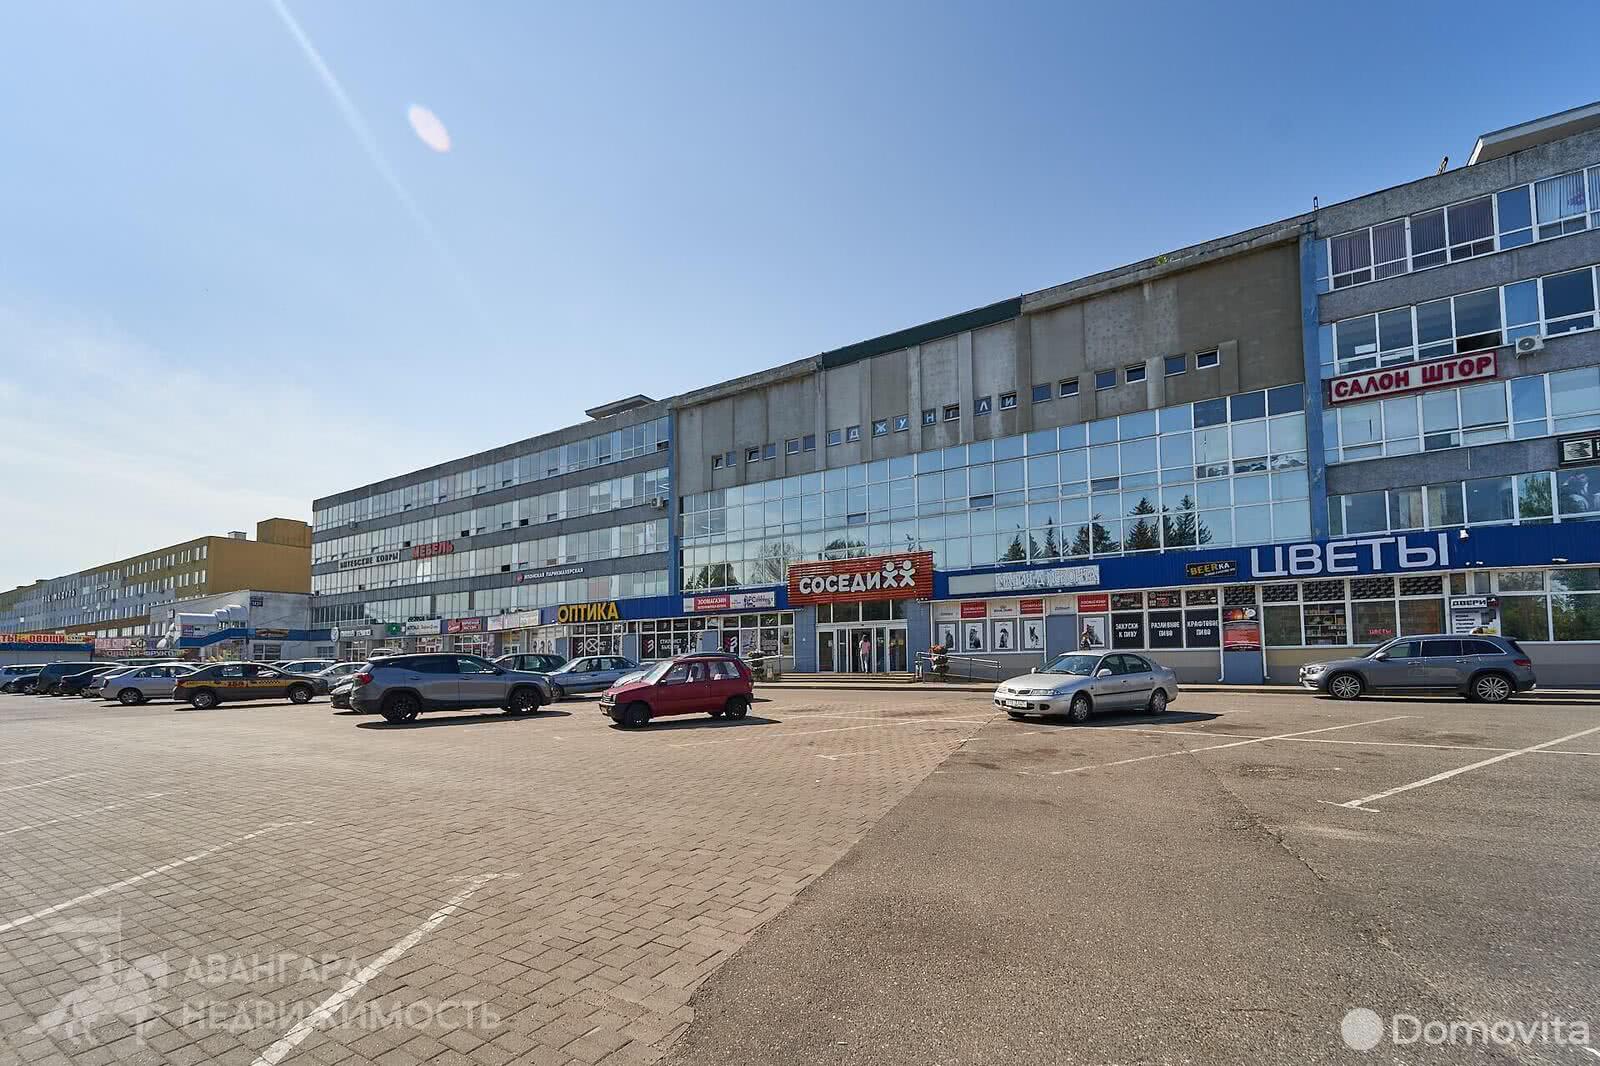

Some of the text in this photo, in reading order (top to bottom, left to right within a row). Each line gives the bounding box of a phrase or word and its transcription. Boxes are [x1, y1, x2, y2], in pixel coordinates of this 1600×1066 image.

[1335, 356, 1492, 398] САЛОН ШТОР
[1250, 533, 1450, 578] ЦВЕТЫ
[799, 571, 881, 595] СОСЕДИ
[558, 601, 619, 623] ОПТИКА
[1452, 599, 1486, 607] ДВЕРИ
[28, 633, 65, 644] ОВОЩИ
